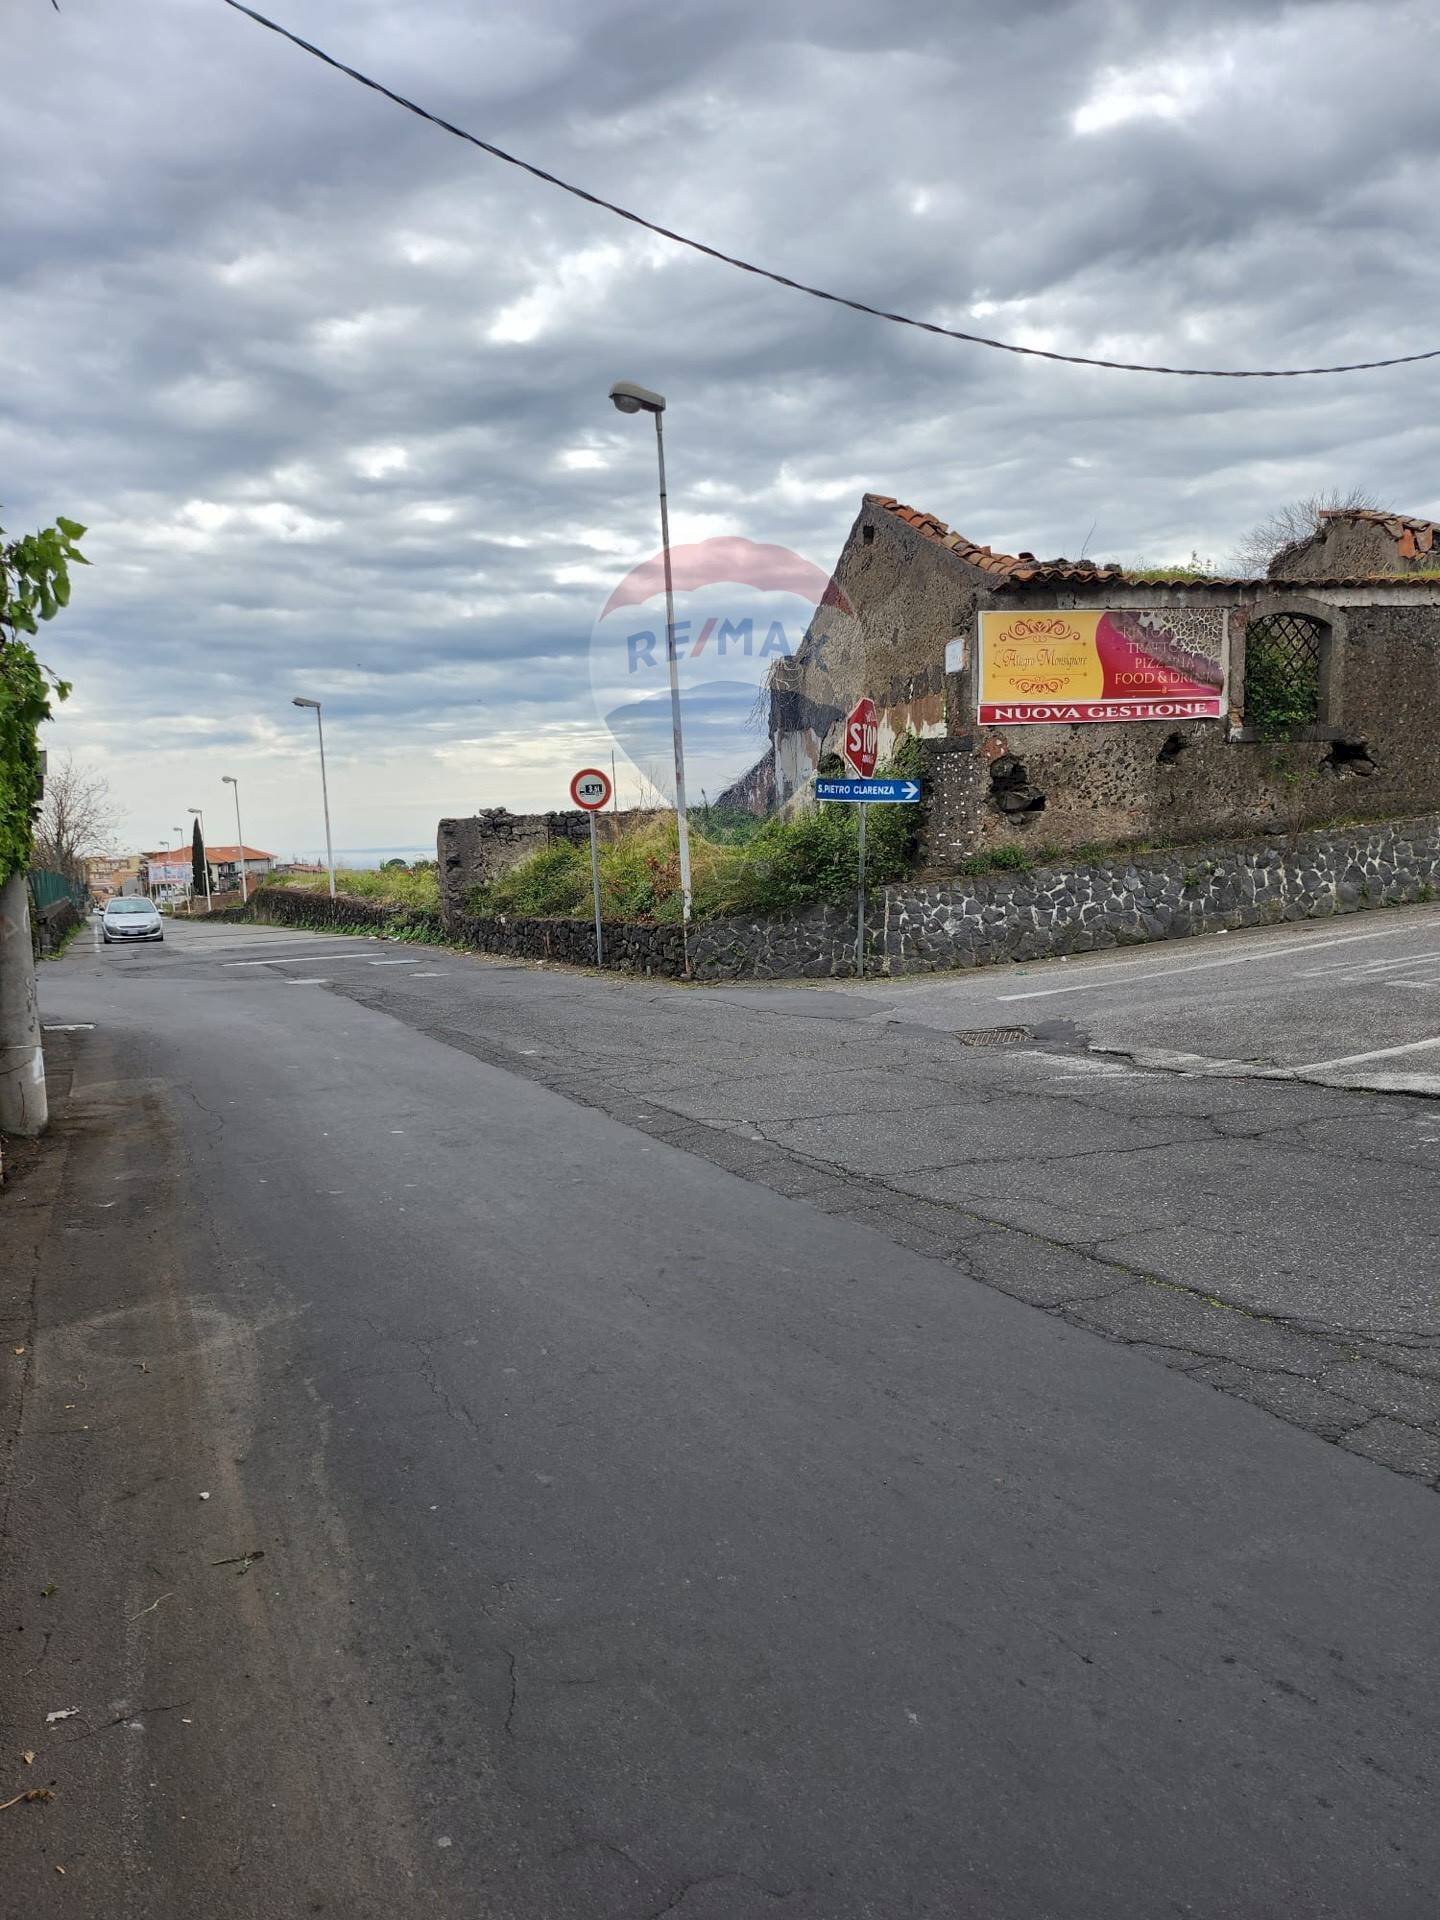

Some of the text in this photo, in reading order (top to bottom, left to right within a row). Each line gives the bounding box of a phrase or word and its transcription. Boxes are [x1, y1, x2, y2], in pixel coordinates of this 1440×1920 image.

[1115, 672, 1154, 685] FOOD
[1157, 670, 1168, 684] &
[995, 703, 1208, 720] NUOVA GESTIONE
[849, 723, 877, 754] STOP
[853, 785, 895, 795] CLARENZA
